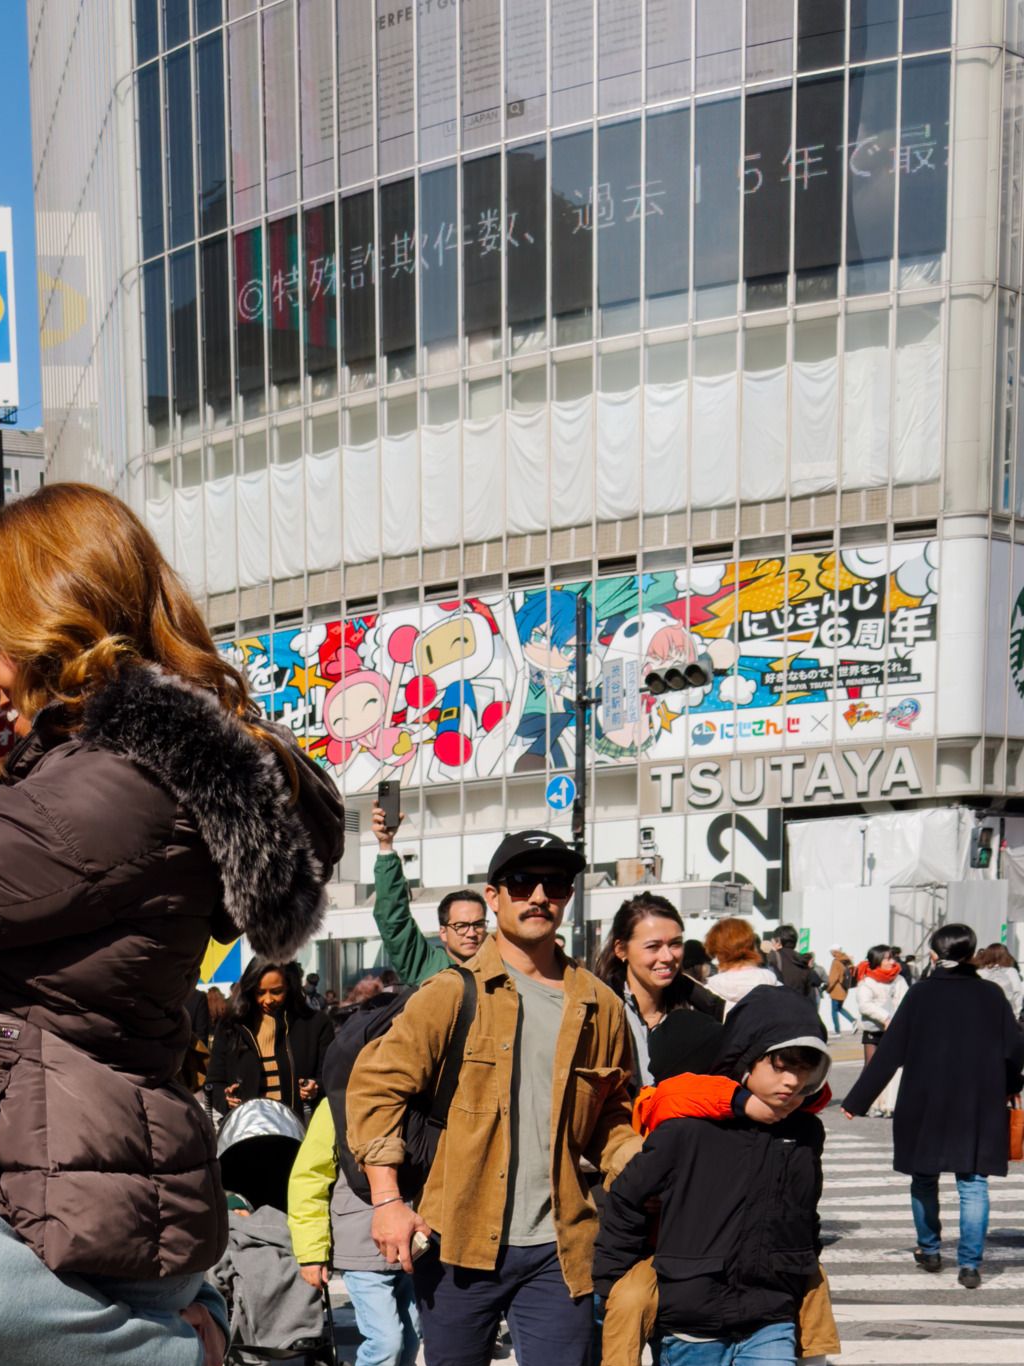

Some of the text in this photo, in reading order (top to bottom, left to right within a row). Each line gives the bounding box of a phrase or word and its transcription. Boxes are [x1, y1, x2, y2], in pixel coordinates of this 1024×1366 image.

[741, 580, 878, 638] にじさんじ
[819, 604, 933, 650] 6周年
[719, 717, 801, 741] にじさんじ
[650, 746, 922, 811] TSUTAYA
